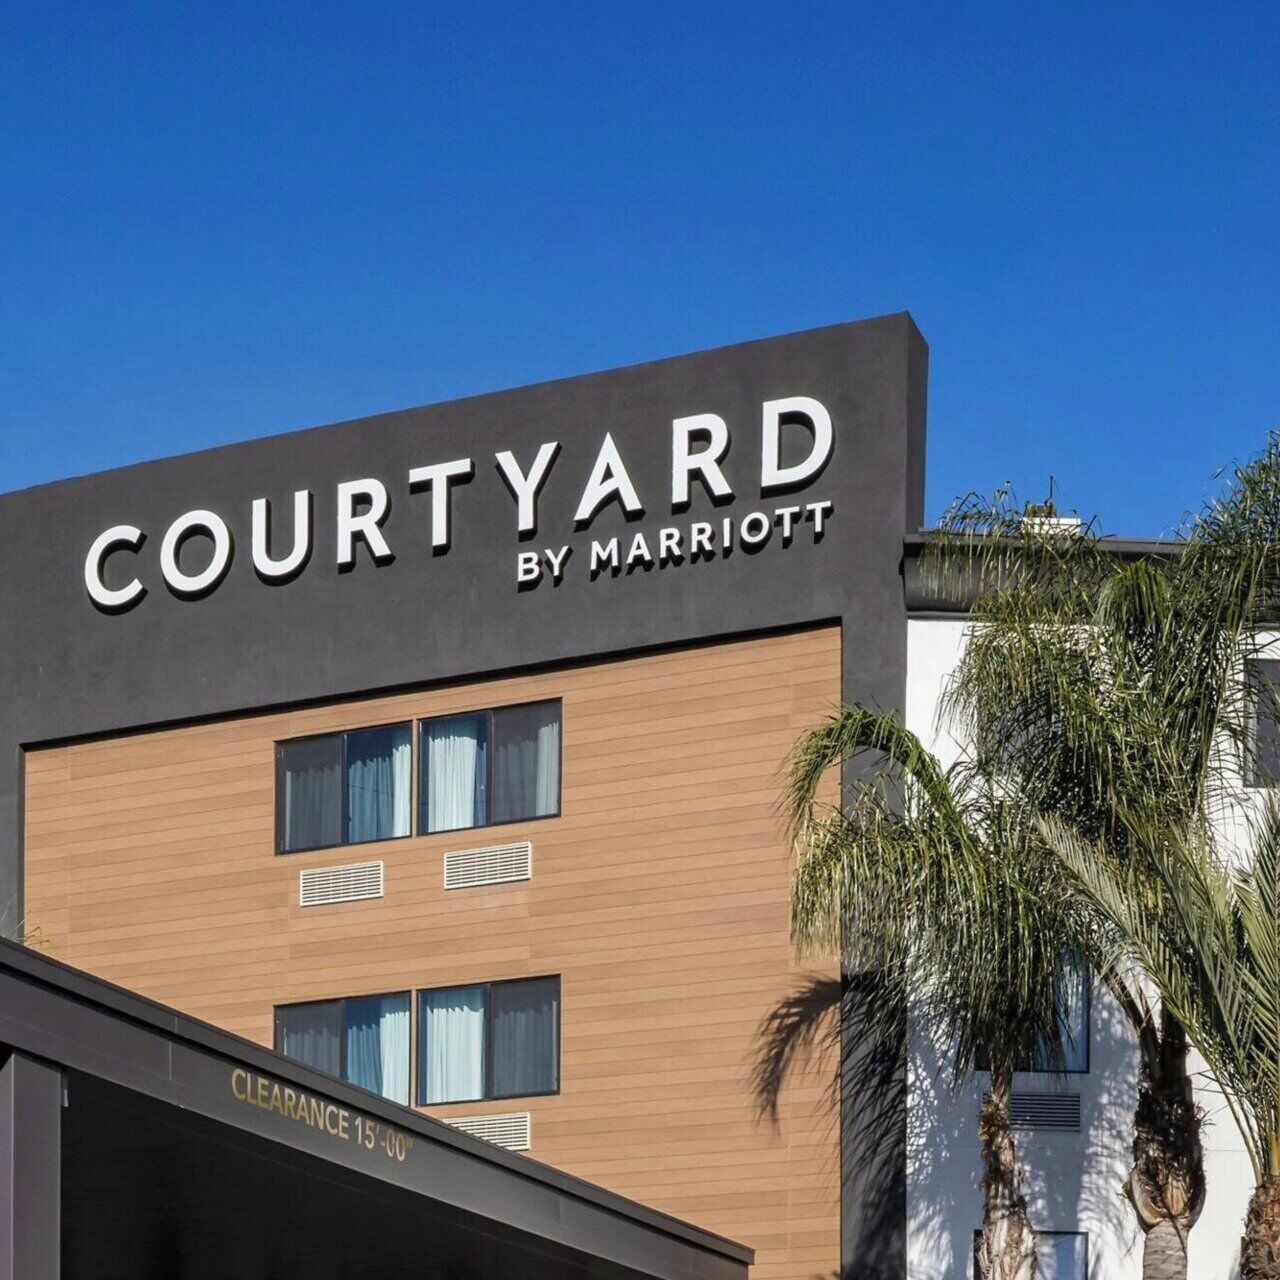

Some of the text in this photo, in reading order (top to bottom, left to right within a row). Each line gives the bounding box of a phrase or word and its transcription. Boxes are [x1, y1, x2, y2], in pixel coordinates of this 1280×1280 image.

[84, 396, 834, 606] COURTYARD
[517, 500, 833, 582] BY MARRIOTT
[231, 1068, 350, 1140] CLEARANCE
